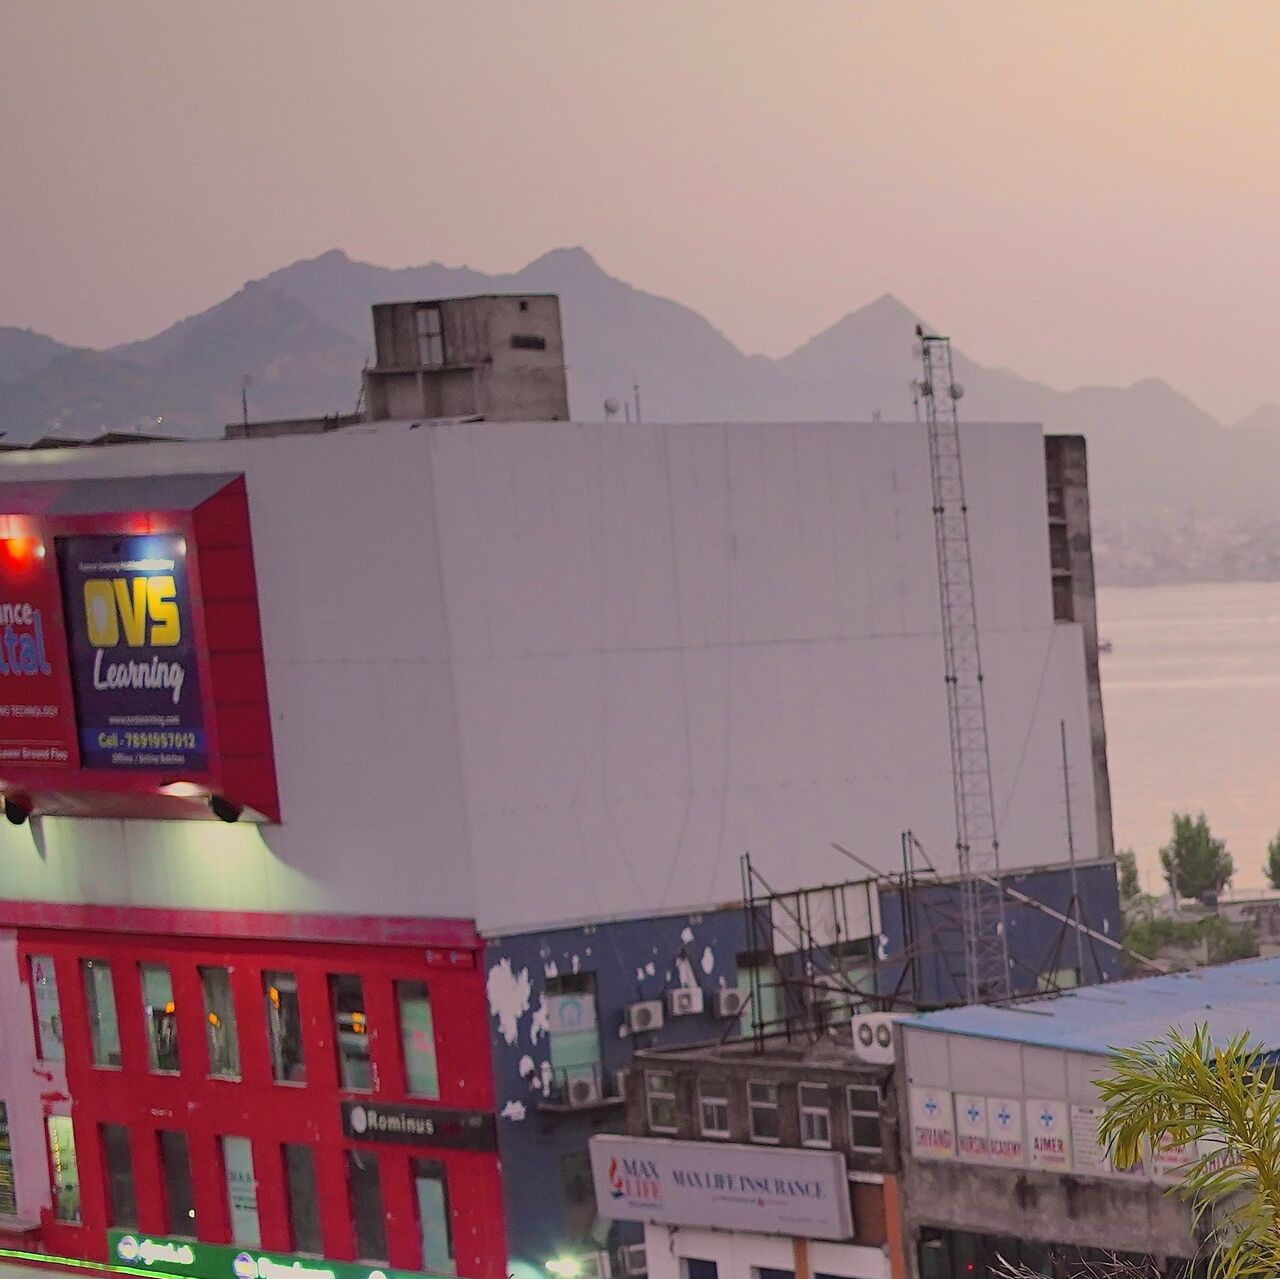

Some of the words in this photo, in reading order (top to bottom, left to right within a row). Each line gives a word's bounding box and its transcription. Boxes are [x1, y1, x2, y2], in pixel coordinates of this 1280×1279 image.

[0, 601, 33, 625] nce
[84, 575, 181, 647] OVS
[93, 648, 185, 704] Learning
[1033, 1137, 1064, 1153] AJMER
[622, 1158, 660, 1179] MAX
[624, 1180, 661, 1199] LIFE
[672, 1170, 701, 1189] MAX
[705, 1171, 735, 1190] LIFE
[738, 1175, 826, 1199] INSURANCE
